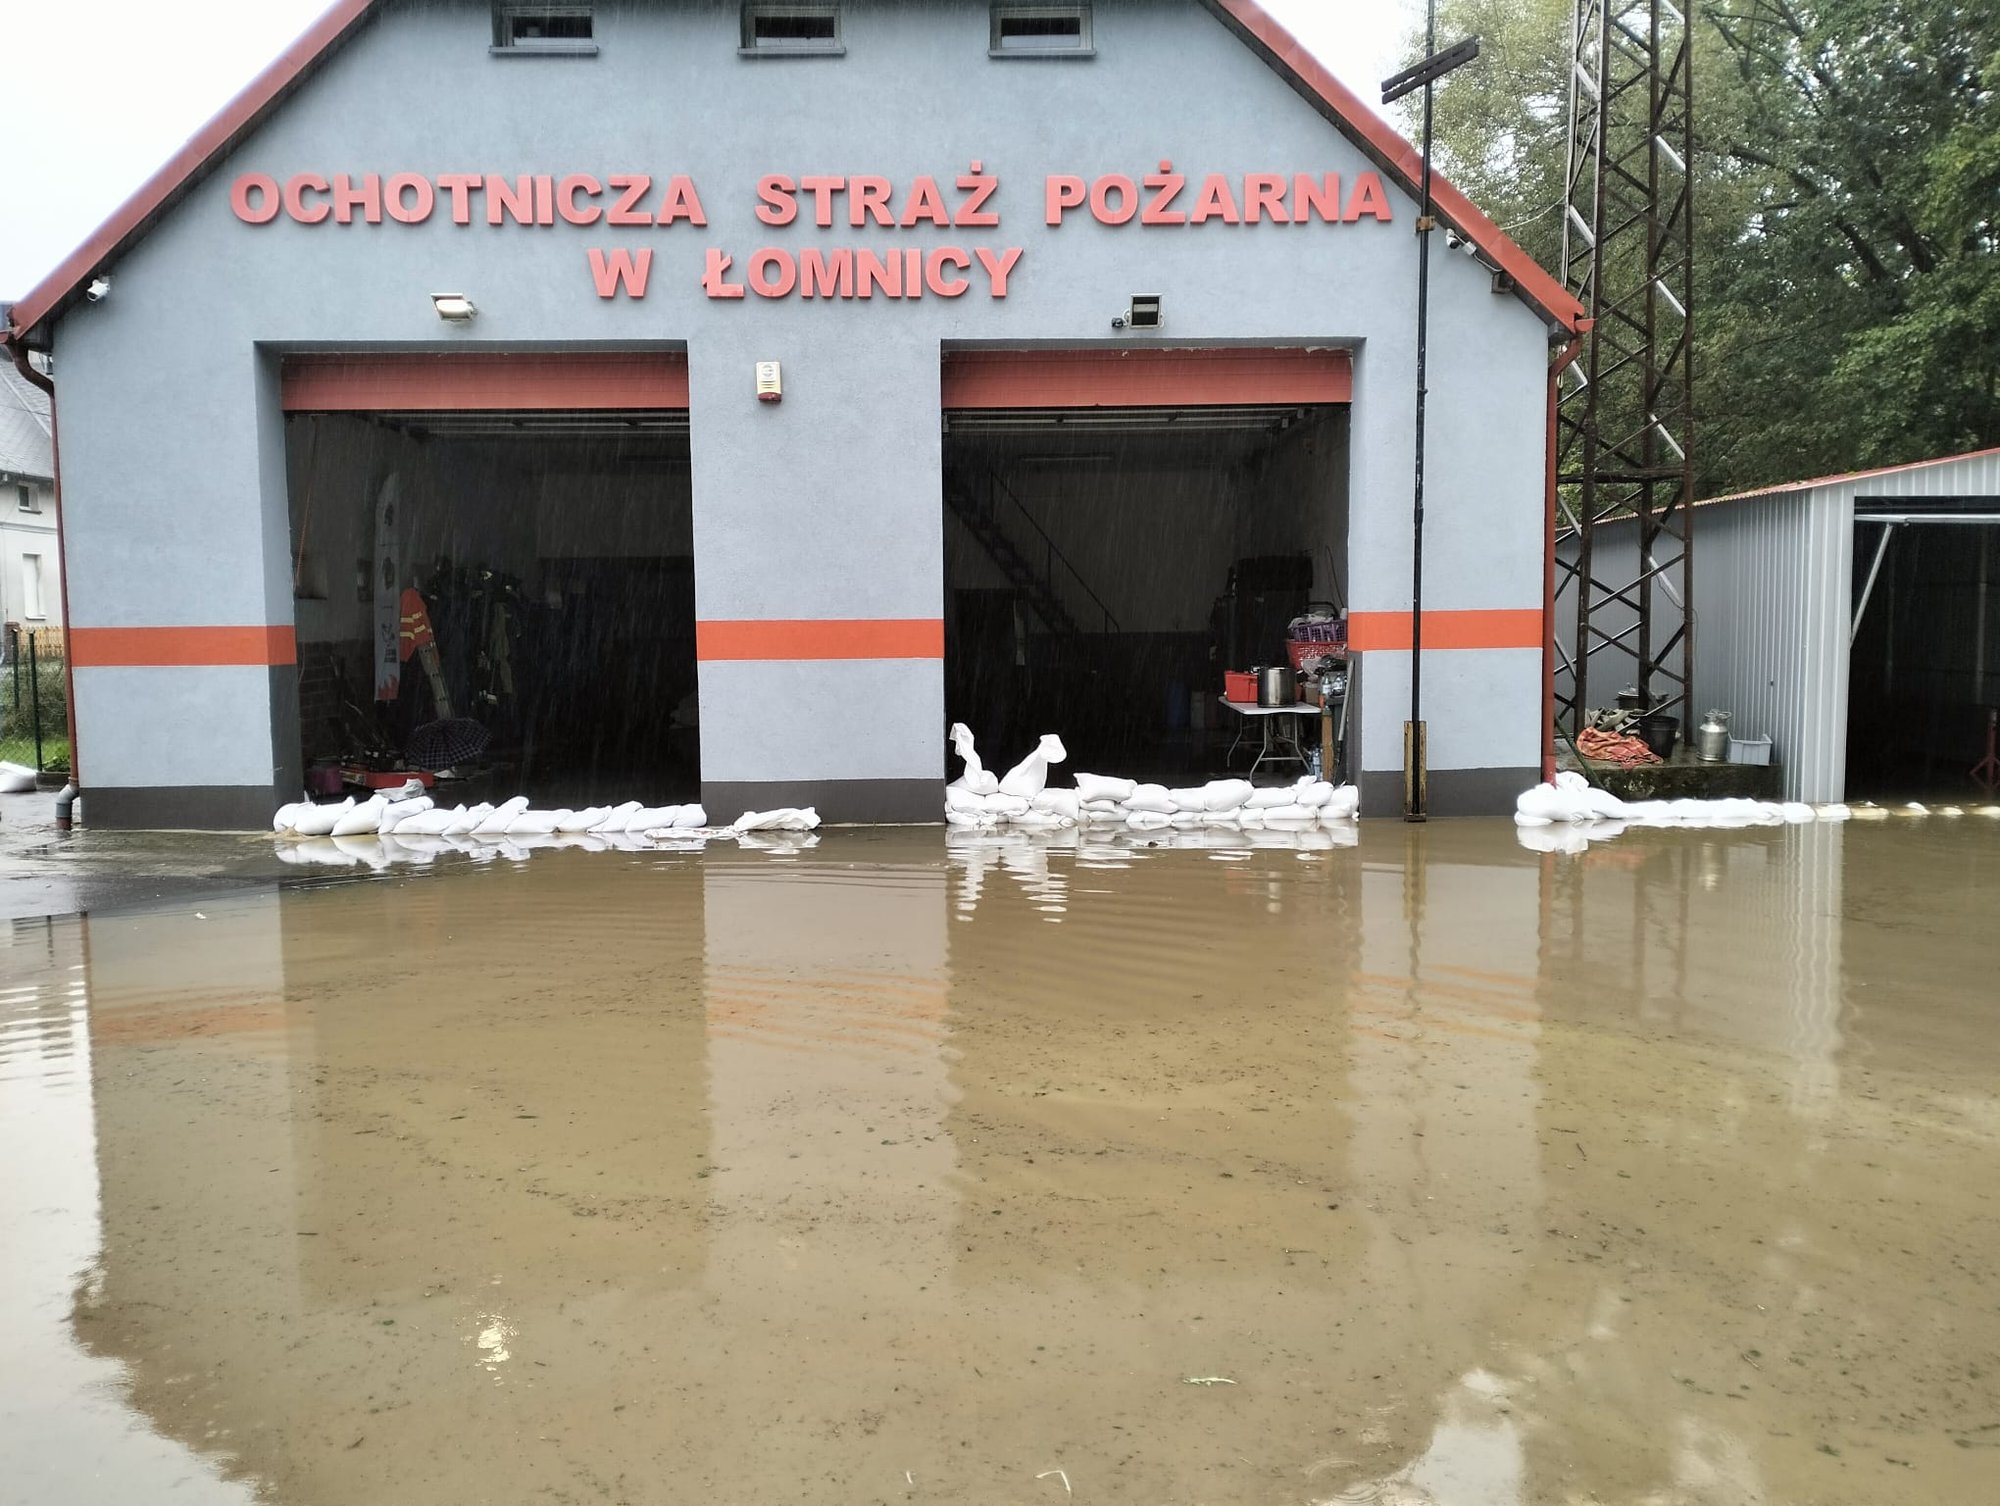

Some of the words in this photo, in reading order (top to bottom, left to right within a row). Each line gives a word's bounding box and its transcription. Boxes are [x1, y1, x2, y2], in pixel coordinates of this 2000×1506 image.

[230, 173, 708, 227] OCHOTNICZA
[755, 160, 1000, 228] STRAŻ
[1045, 159, 1393, 227] POŻARNA
[587, 247, 654, 300] W
[701, 246, 1023, 300] ŁOMNICY
